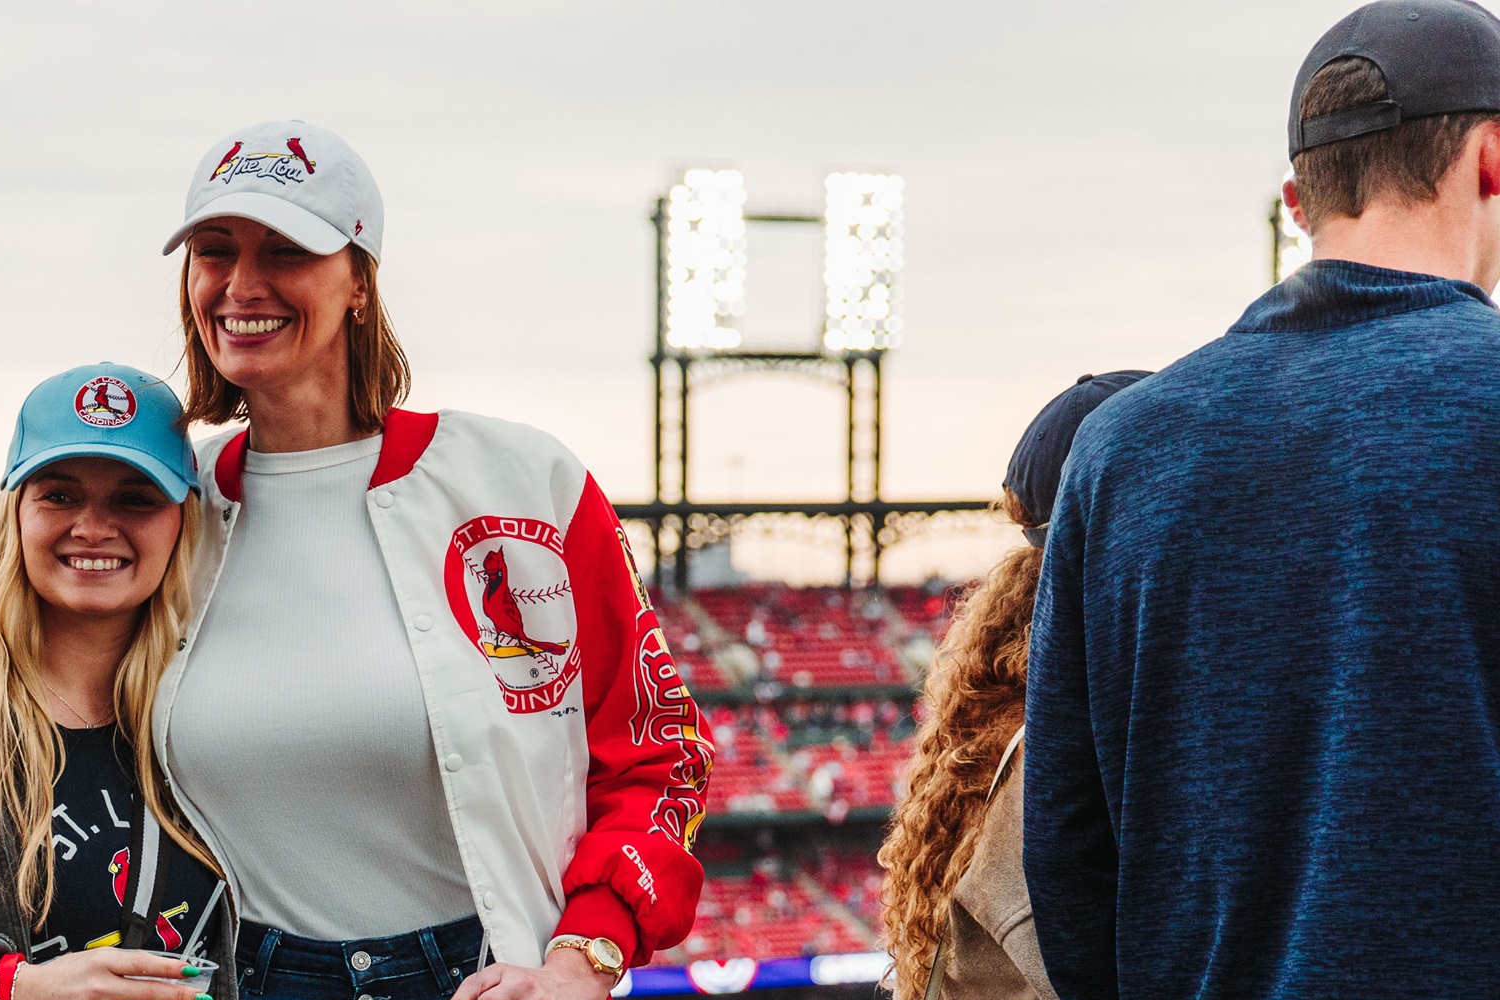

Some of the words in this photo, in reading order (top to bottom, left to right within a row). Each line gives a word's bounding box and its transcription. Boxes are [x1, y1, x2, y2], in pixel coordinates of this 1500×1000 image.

[222, 155, 268, 184] The
[257, 156, 304, 185] Lou
[101, 377, 130, 392] LOUIS
[79, 412, 132, 426] CARDINALS
[453, 523, 481, 554] ST.
[482, 518, 564, 555] LOUIS
[501, 646, 581, 711] DINALS
